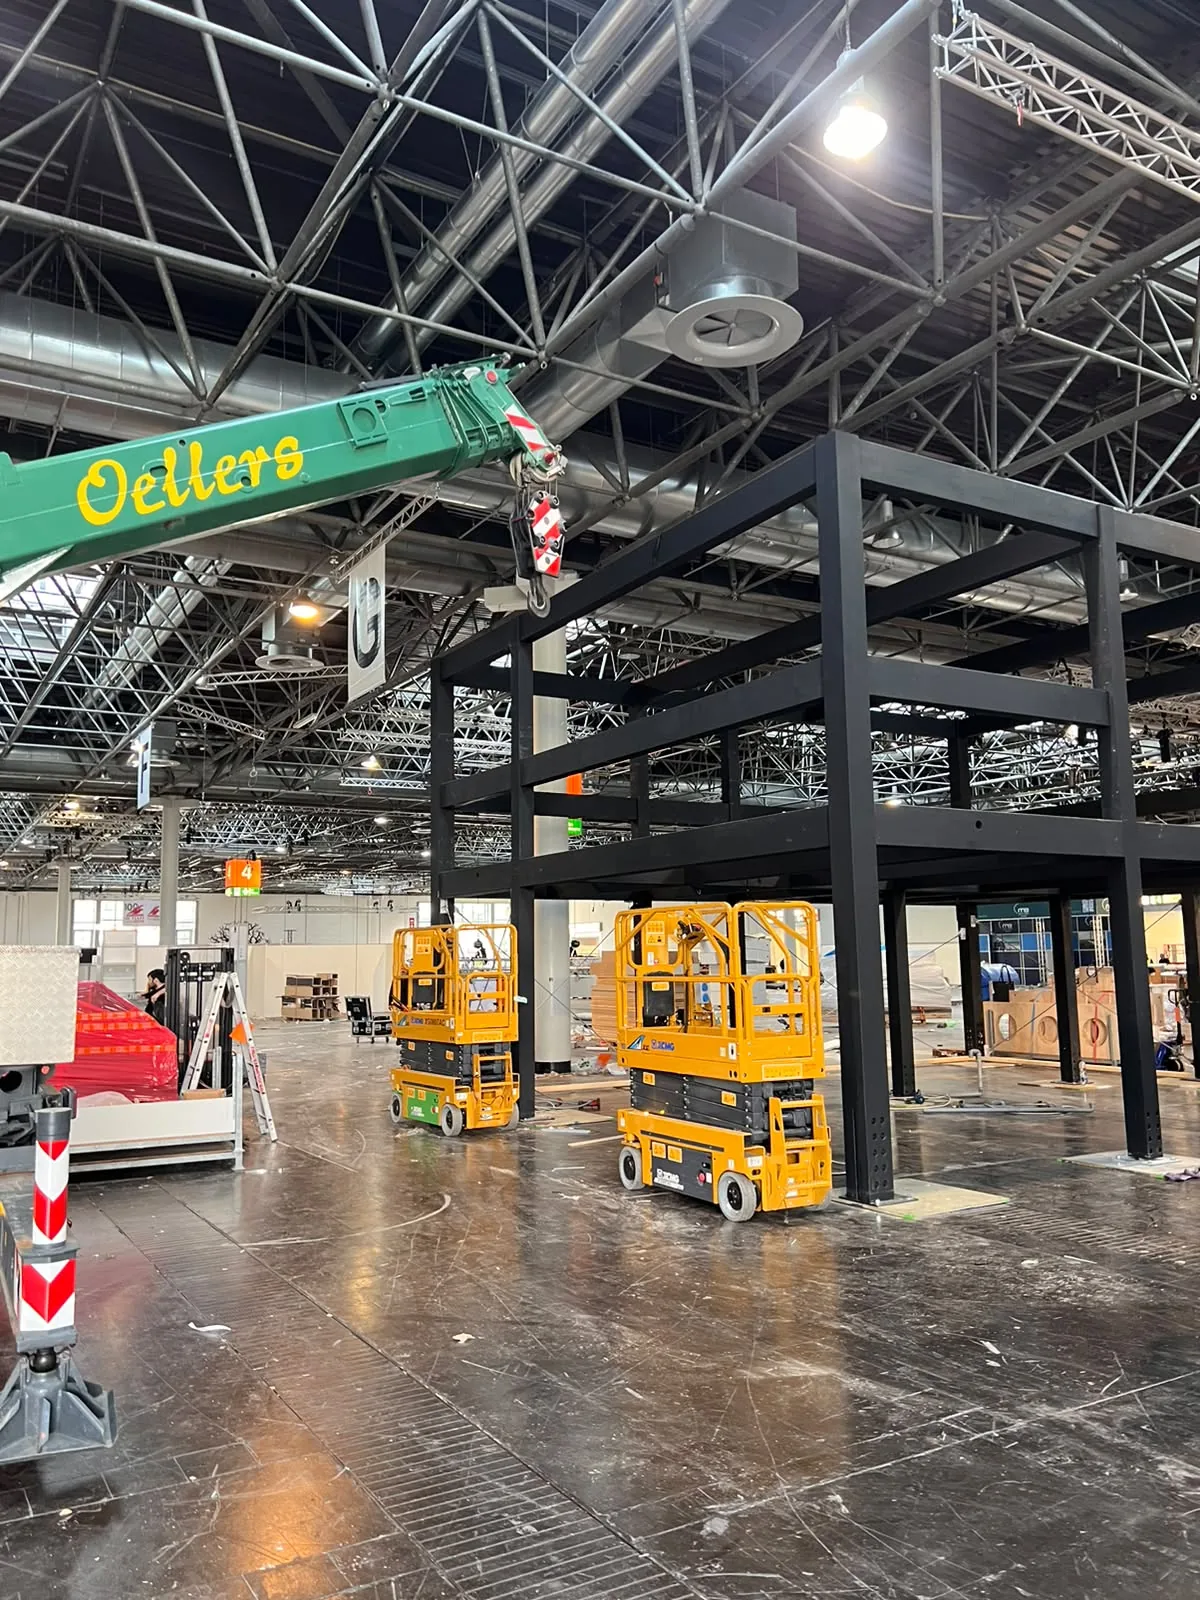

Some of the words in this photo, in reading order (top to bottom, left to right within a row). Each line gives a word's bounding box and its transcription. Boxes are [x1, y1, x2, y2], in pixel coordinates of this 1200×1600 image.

[76, 436, 304, 525] Oellers
[352, 577, 380, 669] G
[241, 863, 253, 881] 4
